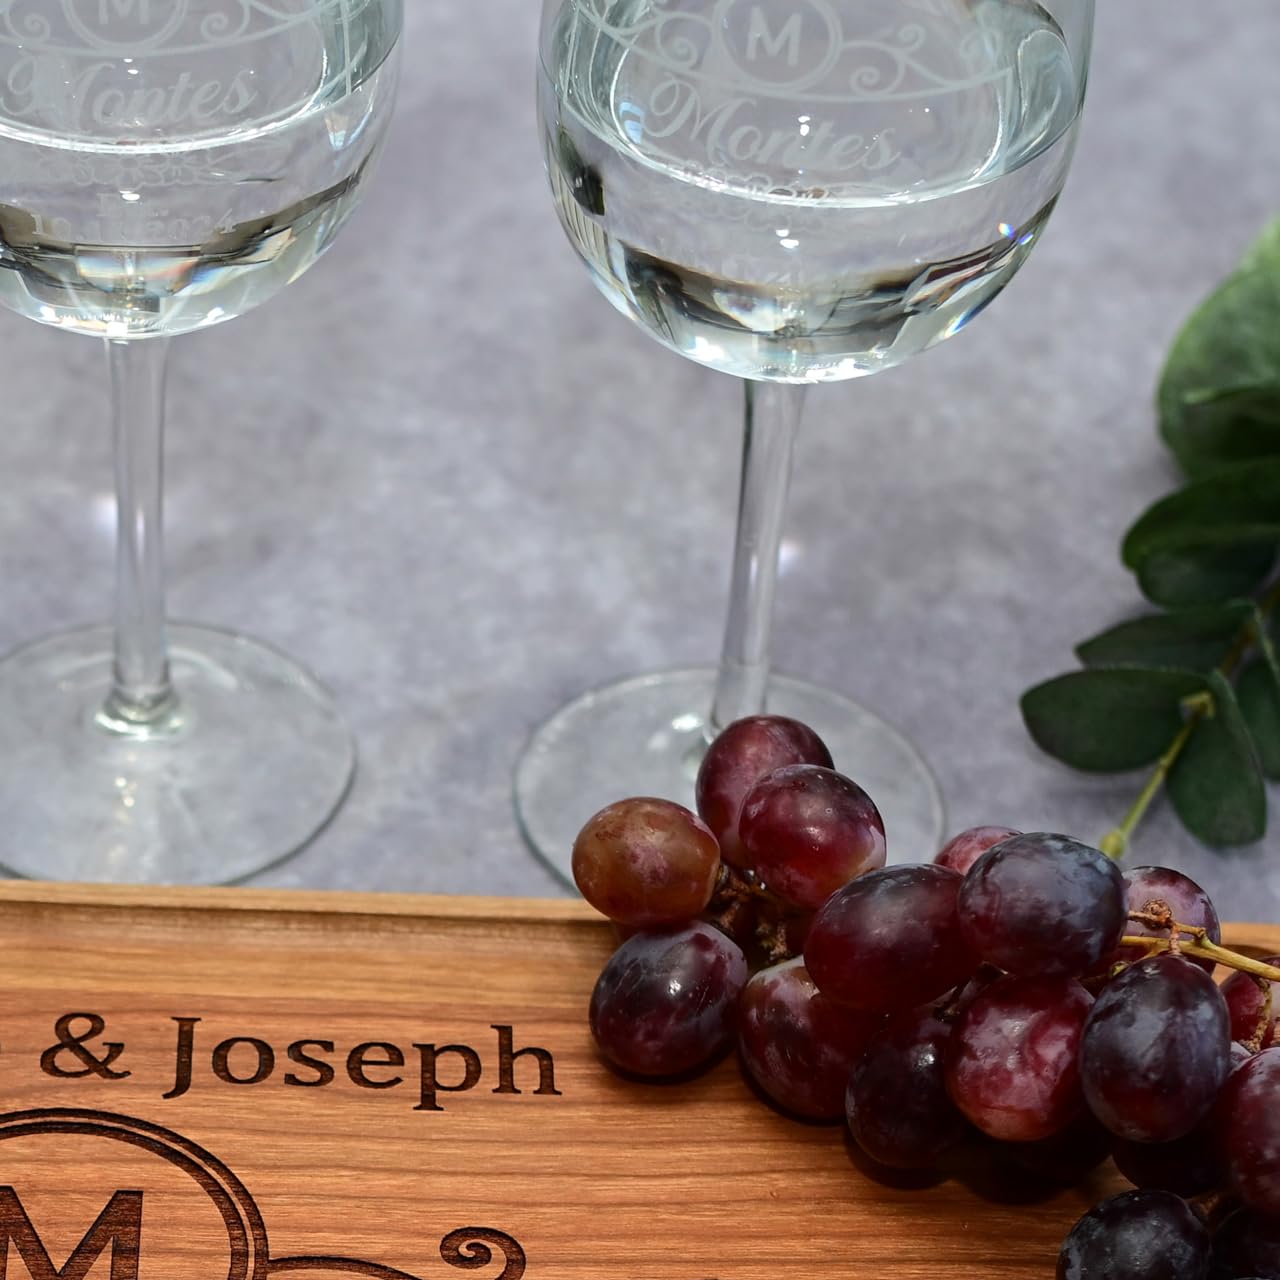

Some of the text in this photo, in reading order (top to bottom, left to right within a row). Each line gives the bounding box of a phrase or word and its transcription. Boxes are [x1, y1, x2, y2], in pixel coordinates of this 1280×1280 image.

[746, 6, 803, 67] M
[0, 50, 258, 136] Montes
[641, 71, 903, 168] Montes
[39, 1011, 133, 1081] &
[161, 1014, 563, 1112] Joseph
